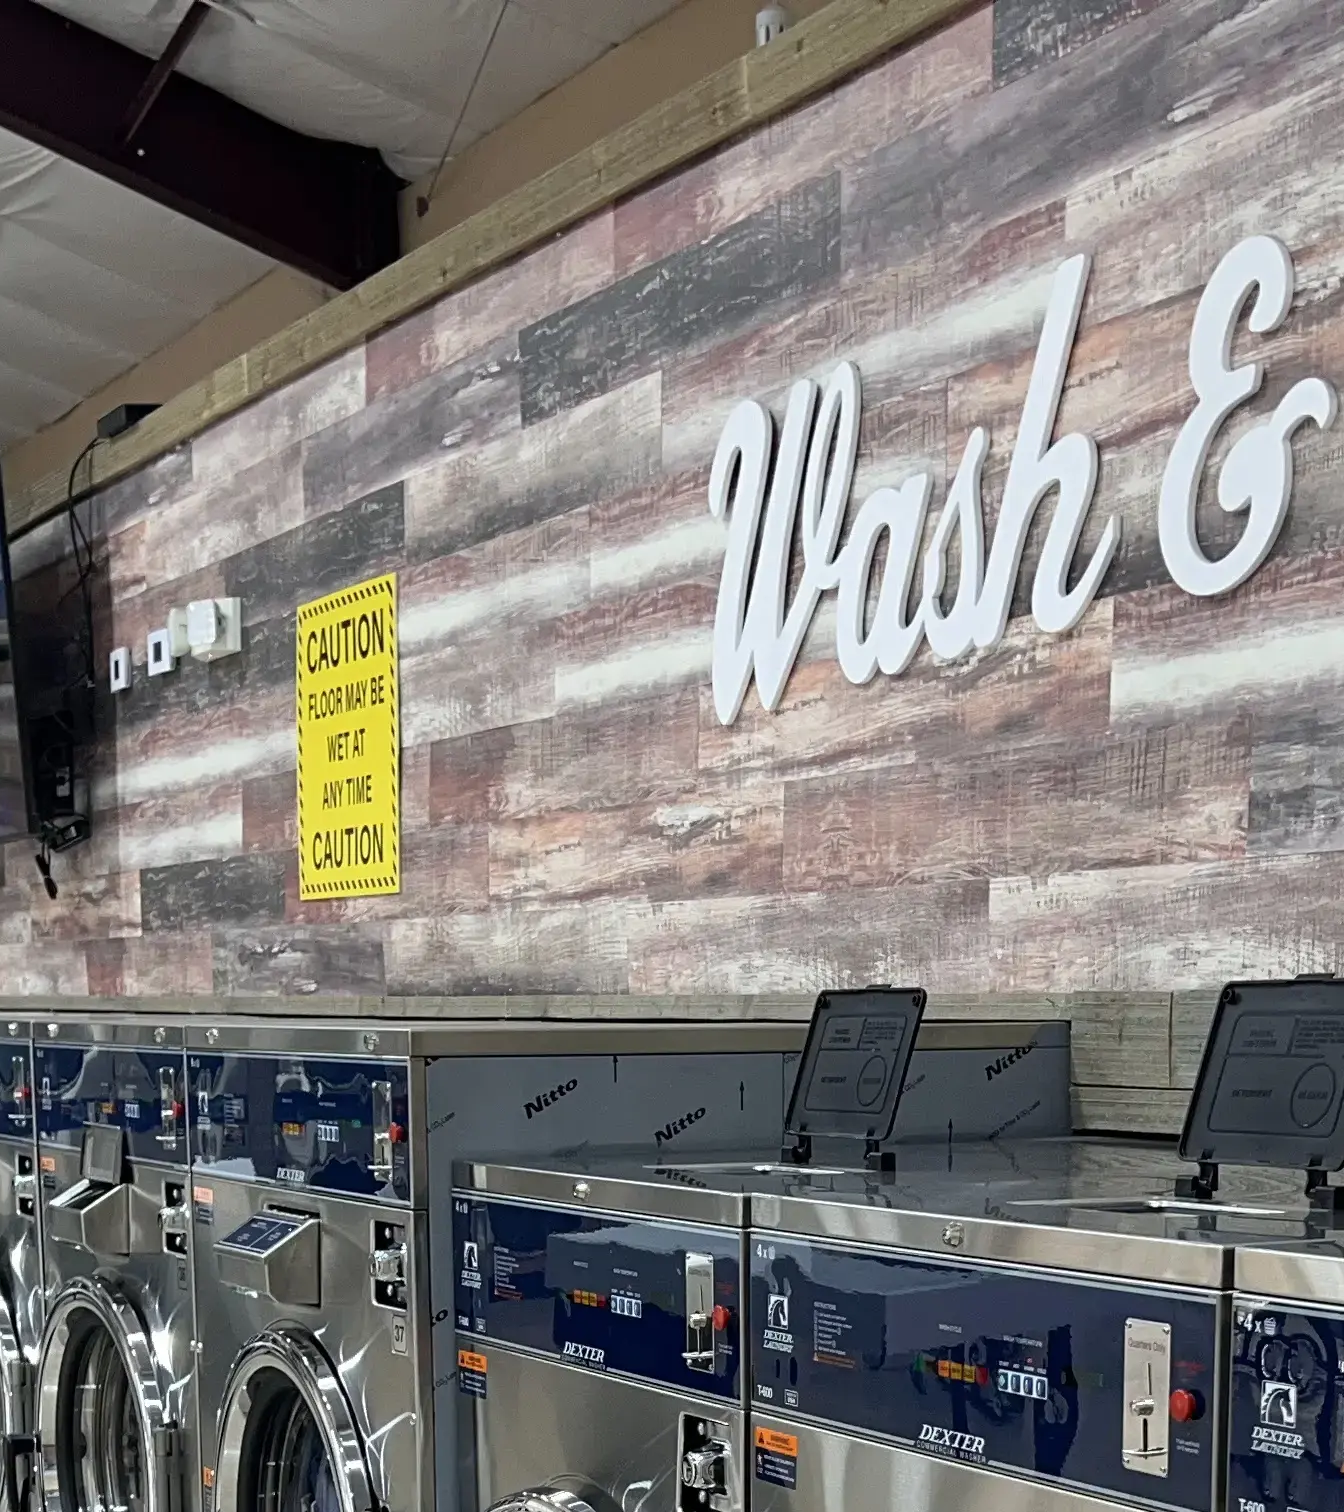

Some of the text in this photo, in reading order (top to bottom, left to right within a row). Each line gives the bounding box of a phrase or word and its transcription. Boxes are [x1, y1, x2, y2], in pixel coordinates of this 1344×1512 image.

[707, 254, 1121, 726] Wash
[1157, 233, 1340, 597] &
[307, 607, 384, 675] CAUTION
[308, 675, 385, 722] FLOOR MAY BE
[327, 728, 365, 763] WET AT
[323, 775, 373, 811] ANY TIME
[312, 823, 384, 871] CAUTION
[523, 1078, 578, 1119] Nitto
[654, 1107, 706, 1148] Nitto
[277, 1167, 305, 1182] DEXTER
[394, 1325, 404, 1343] 37
[763, 1329, 794, 1343] DEXTER
[1243, 1313, 1253, 1331] 4
[563, 1341, 605, 1363] DEXTER
[919, 1423, 985, 1453] DEXTER
[1251, 1426, 1305, 1446] DEXTER
